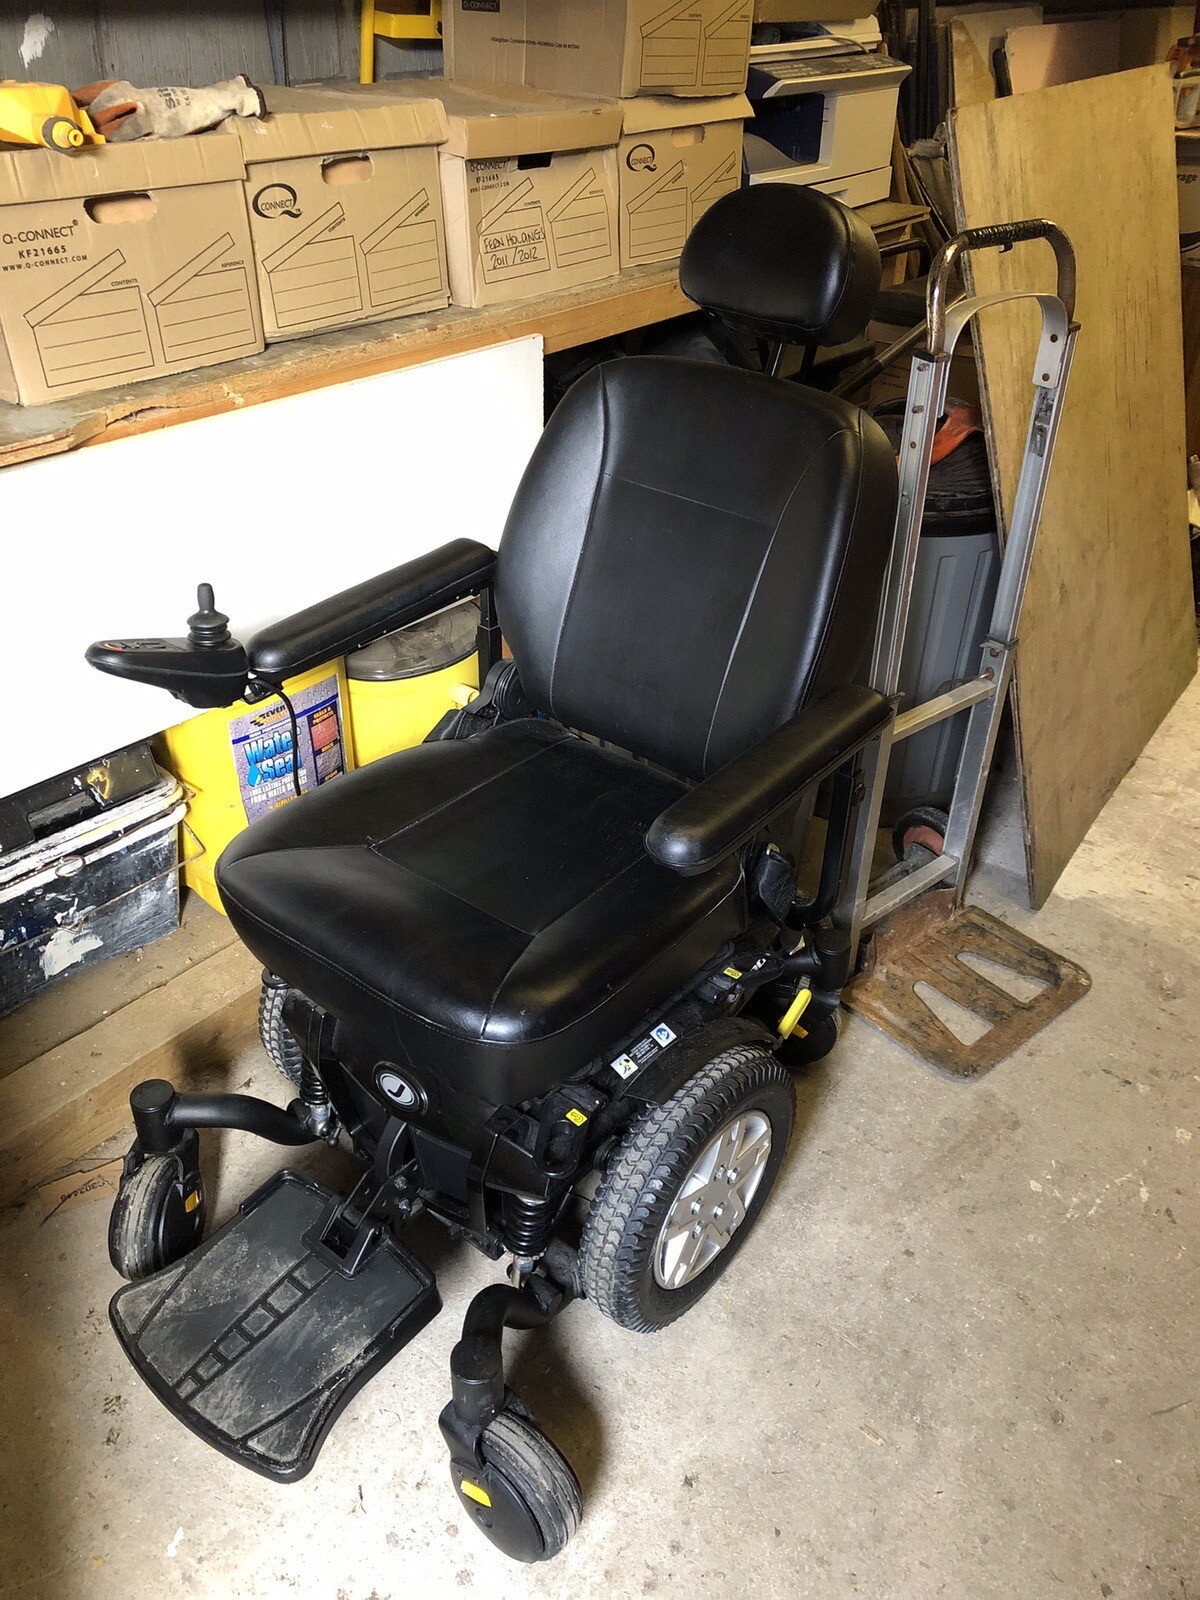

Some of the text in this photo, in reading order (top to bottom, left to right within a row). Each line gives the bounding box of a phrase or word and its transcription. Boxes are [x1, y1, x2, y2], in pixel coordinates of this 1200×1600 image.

[469, 160, 507, 173] Q-CONNECT
[1177, 173, 1198, 184] rage
[260, 198, 294, 212] CONNECT
[18, 245, 67, 259] KF21665
[2, 254, 88, 272] WWW.Q-CONNECT.COM
[110, 278, 139, 287] CONTENTS
